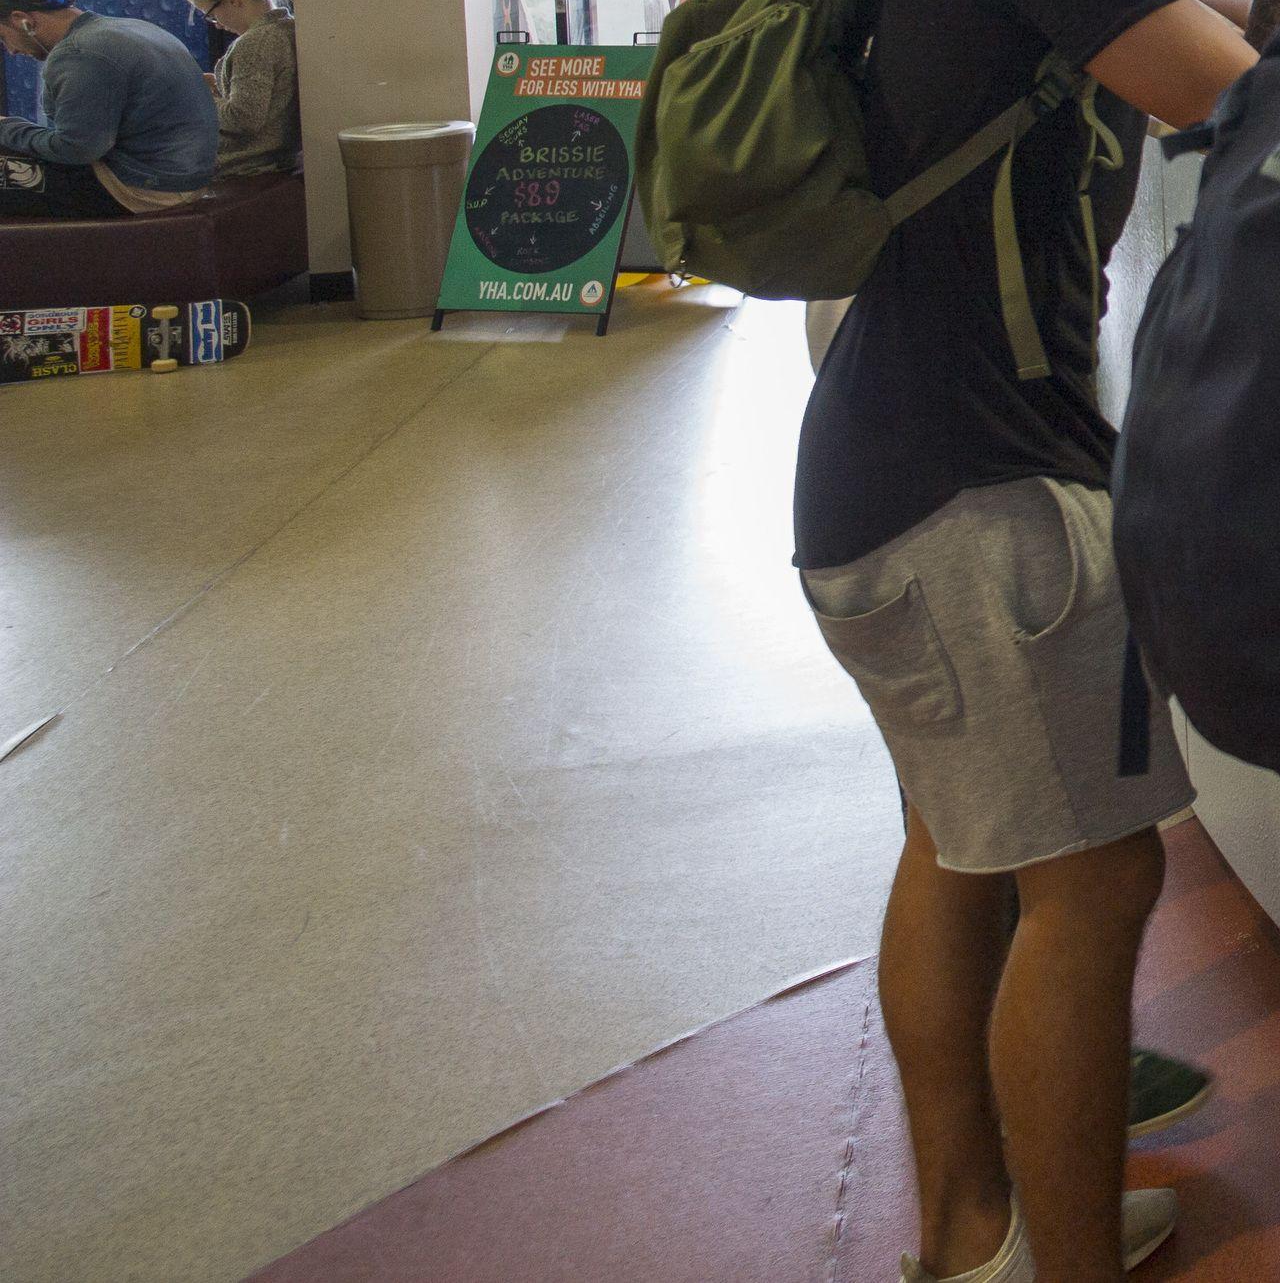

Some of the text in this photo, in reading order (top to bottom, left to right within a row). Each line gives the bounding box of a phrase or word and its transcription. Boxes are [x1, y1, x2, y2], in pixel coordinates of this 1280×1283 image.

[530, 57, 602, 77] SEE MORE
[518, 80, 643, 97] FOR LESS WITH YHA
[519, 144, 606, 164] BRISSIE
[495, 166, 607, 181] ADVENTURE
[513, 180, 561, 208] $89
[500, 210, 580, 224] PACKAGE
[479, 280, 574, 302] YHA.COM.AU
